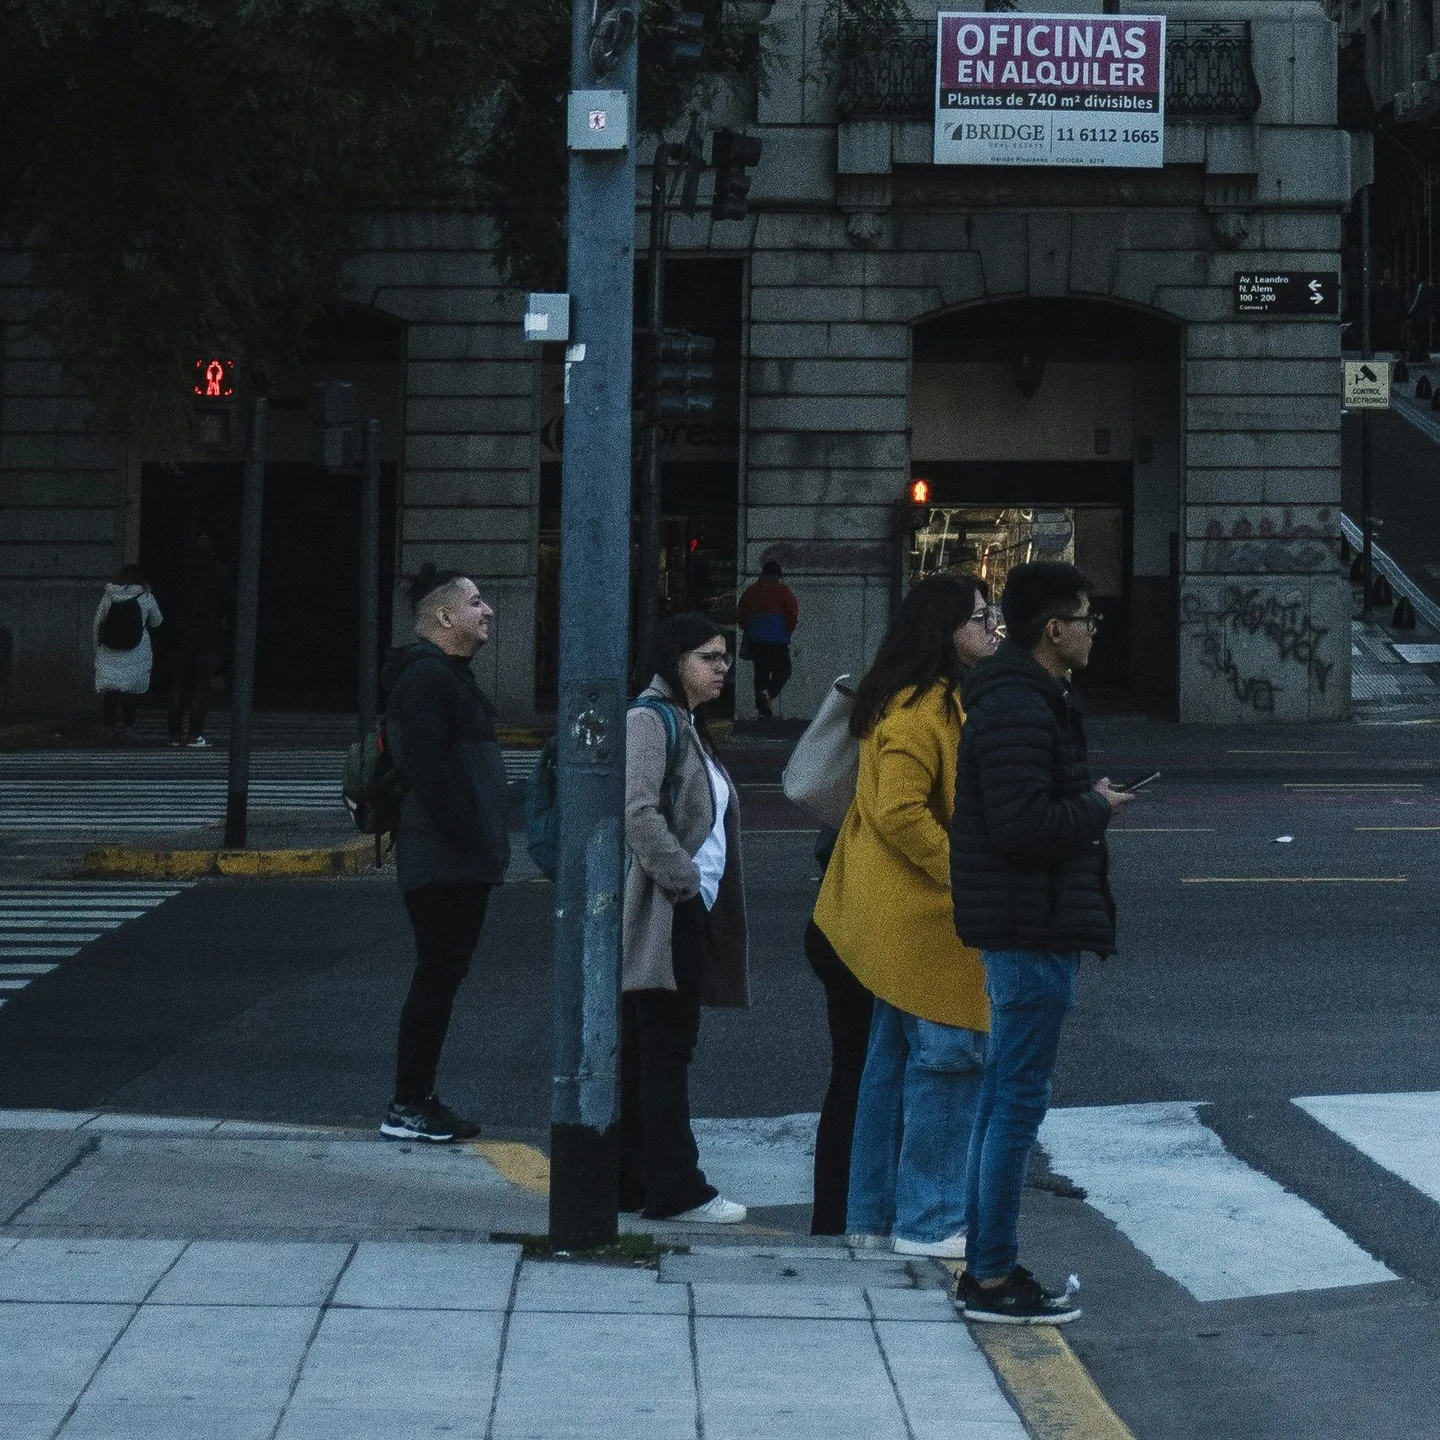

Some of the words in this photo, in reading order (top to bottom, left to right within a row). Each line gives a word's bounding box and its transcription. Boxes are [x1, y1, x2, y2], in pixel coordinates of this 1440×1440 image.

[956, 23, 1147, 60] OFICINAS
[957, 60, 996, 84] EN
[1001, 61, 1146, 86] ALQUILER
[947, 93, 1002, 107] Plantas
[1006, 93, 1024, 107] de
[1027, 93, 1057, 107] 740
[1061, 95, 1081, 108] m²
[1084, 94, 1154, 110] divisibles
[965, 123, 1045, 142] BRIDGE
[1057, 127, 1075, 141] 11
[1079, 128, 1117, 143] 6112
[1122, 129, 1160, 144] 1665
[1239, 275, 1252, 284] Av.
[1254, 275, 1289, 284] Leandro
[1239, 285, 1248, 293] N.
[1250, 285, 1273, 293] Alem
[1239, 294, 1253, 302] 100
[1260, 294, 1276, 302] 200
